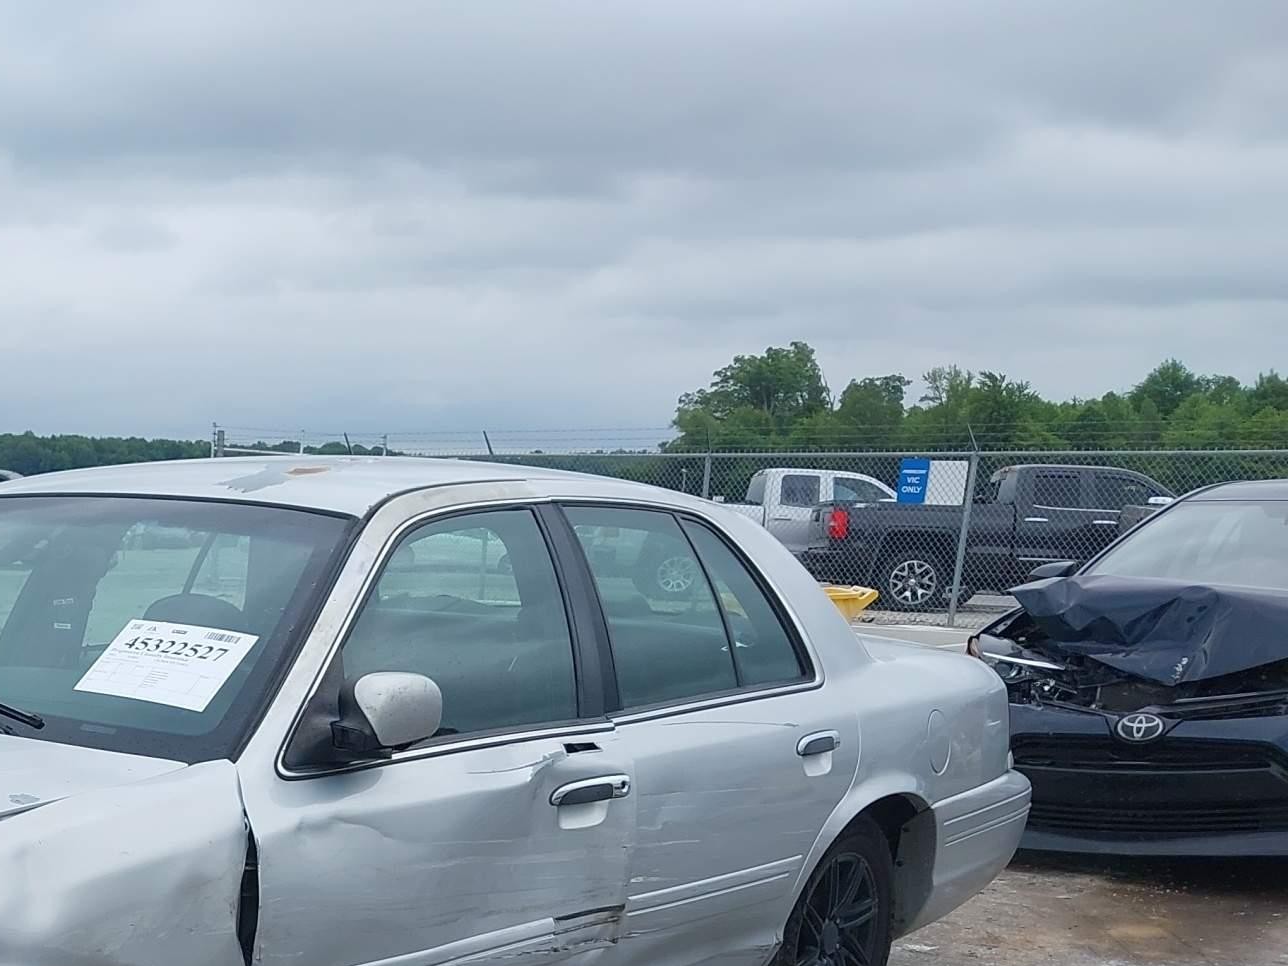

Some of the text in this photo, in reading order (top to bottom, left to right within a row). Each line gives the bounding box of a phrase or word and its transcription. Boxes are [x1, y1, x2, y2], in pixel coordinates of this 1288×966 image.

[906, 476, 920, 484] VIC
[901, 485, 923, 493] ONLY
[124, 636, 229, 662] 45322527
